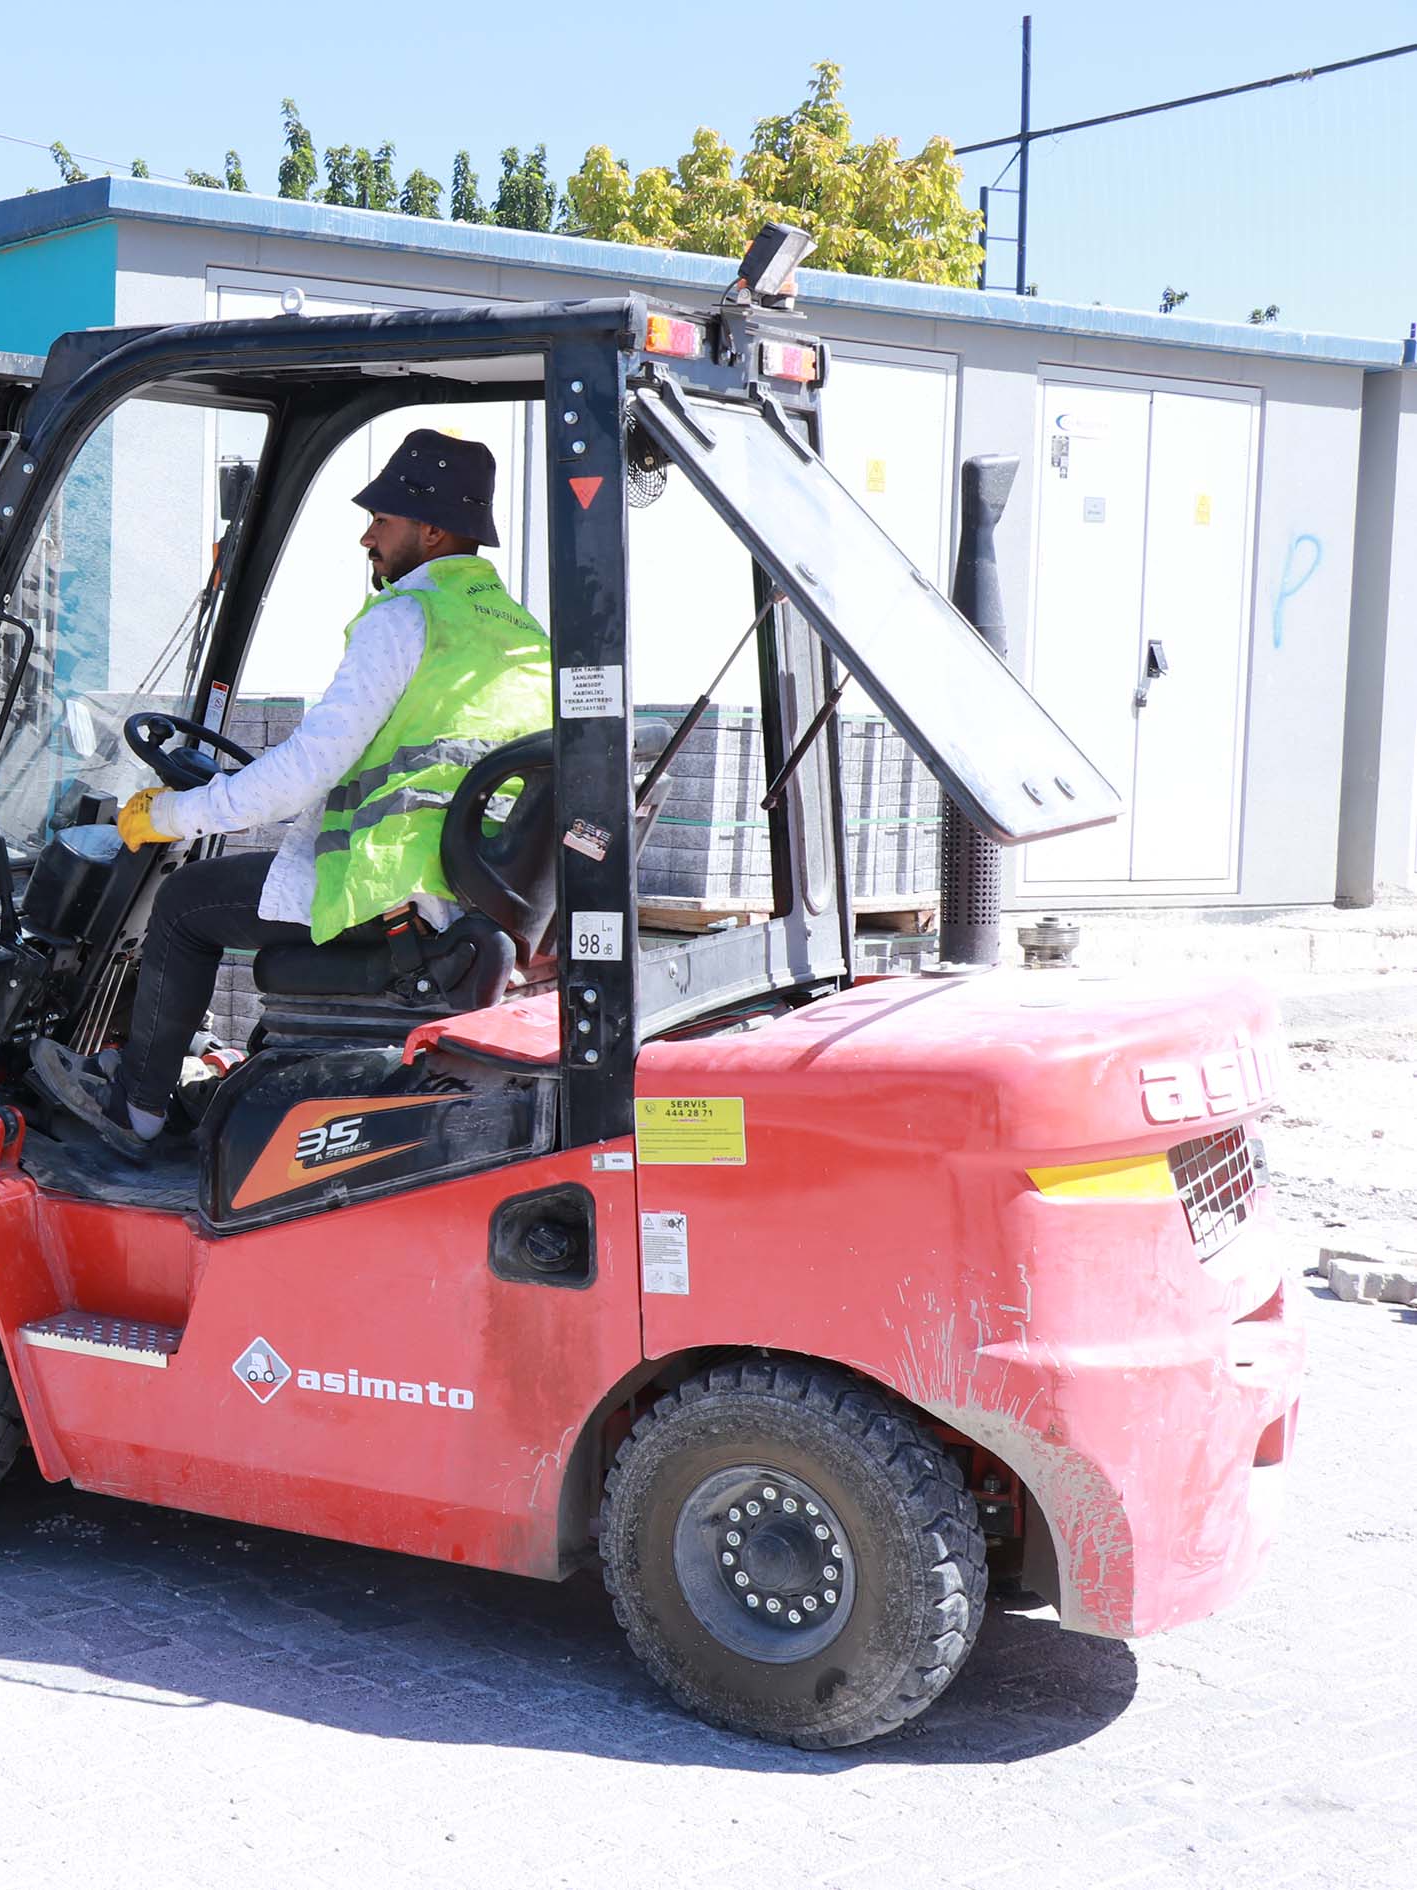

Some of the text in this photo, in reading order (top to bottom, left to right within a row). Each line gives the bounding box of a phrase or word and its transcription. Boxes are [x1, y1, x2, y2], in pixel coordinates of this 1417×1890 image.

[579, 933, 613, 955] 98 dB
[665, 1109, 713, 1117] 444 28 71
[295, 1117, 362, 1158] 35
[325, 1141, 371, 1159] SERIES
[297, 1368, 474, 1410] asimato
